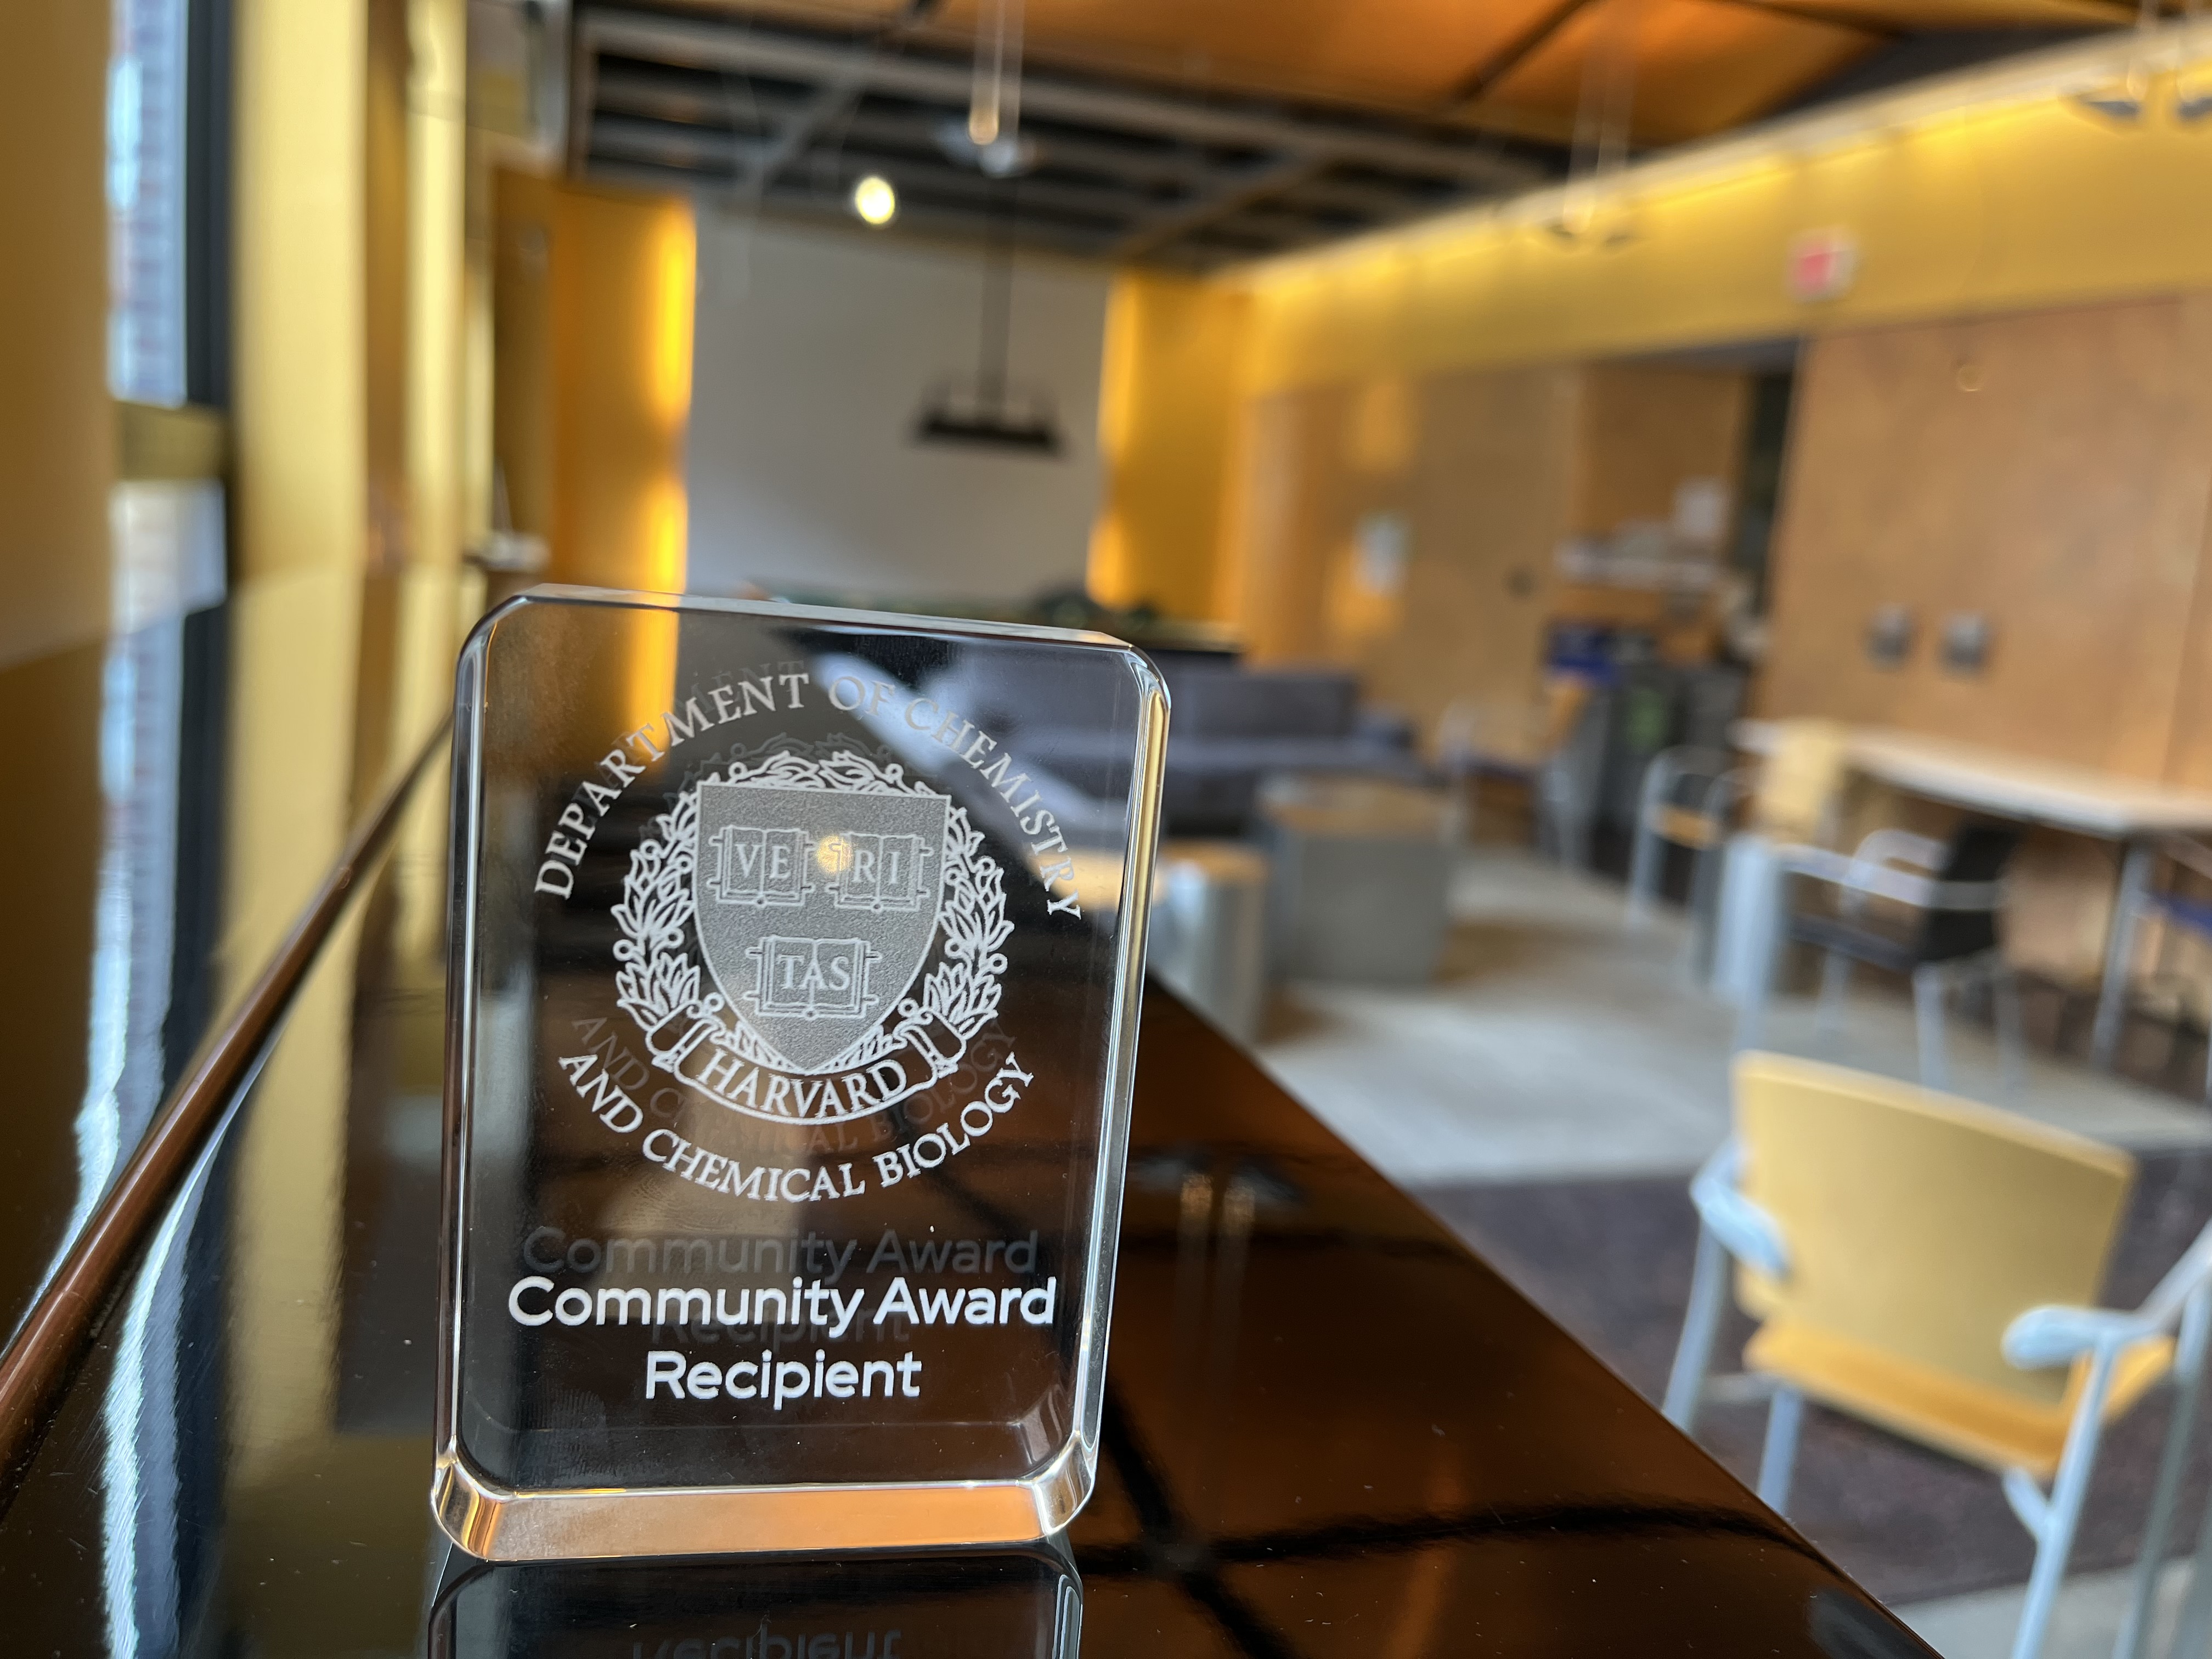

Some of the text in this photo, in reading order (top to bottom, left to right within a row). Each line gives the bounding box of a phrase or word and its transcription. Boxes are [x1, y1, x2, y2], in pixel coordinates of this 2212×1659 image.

[534, 673, 1081, 919] DEPARTMENT OF CHEMISTRY
[735, 843, 900, 884] VE RI
[777, 954, 850, 991] TAS
[696, 1047, 907, 1118] HARVARD
[558, 1054, 644, 1133] AND
[642, 1128, 866, 1202] CHEMICAL
[872, 1052, 1034, 1188] BIOLOGY
[509, 1276, 865, 1338] Community
[873, 1277, 1056, 1324] Award
[646, 1349, 922, 1410] Recipient
